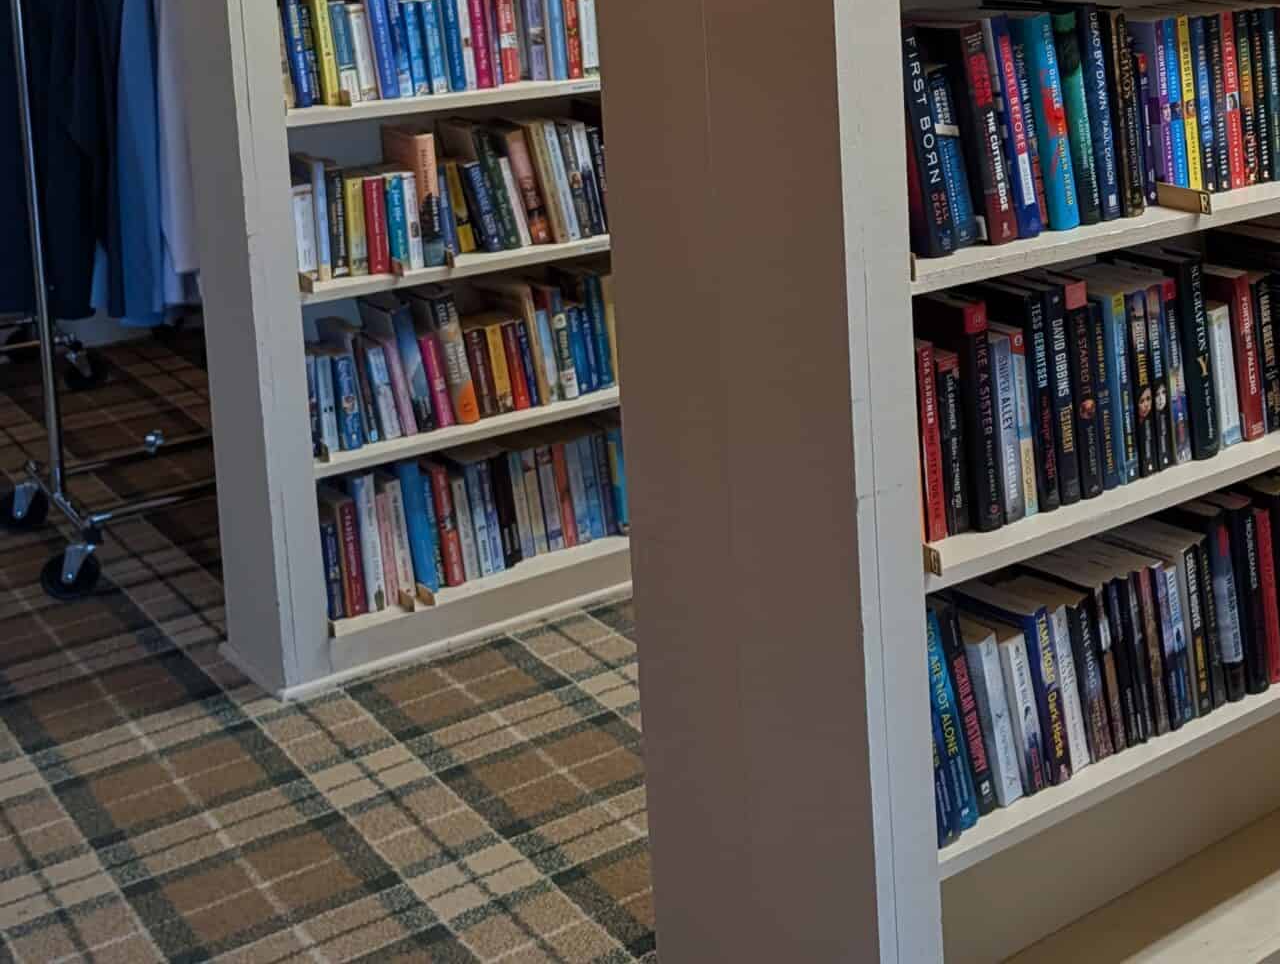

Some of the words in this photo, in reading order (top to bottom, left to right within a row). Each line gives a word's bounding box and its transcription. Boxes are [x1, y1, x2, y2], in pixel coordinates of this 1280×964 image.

[905, 35, 928, 107] FIRST
[1093, 50, 1104, 67] BY
[1004, 61, 1016, 93] GIRL
[1093, 70, 1110, 111] DAWN
[986, 111, 997, 133] THE
[1009, 97, 1026, 150] BEFORE
[988, 134, 1005, 180] CUTTING
[996, 182, 1009, 212] EDGE
[1030, 303, 1044, 329] TESS
[1192, 293, 1208, 351] GRAFTON
[974, 335, 987, 365] LIKE
[1050, 319, 1065, 350] DAVID
[979, 373, 988, 382] A
[1053, 353, 1070, 397] GIBBINS
[978, 386, 995, 435] SISTER
[1058, 404, 1077, 453] TESTAMENT
[1036, 616, 1052, 649] TAMI
[929, 656, 945, 684] ARE
[1040, 649, 1059, 685] HOAG
[934, 683, 949, 710] NOT
[940, 713, 959, 757] ALONE
